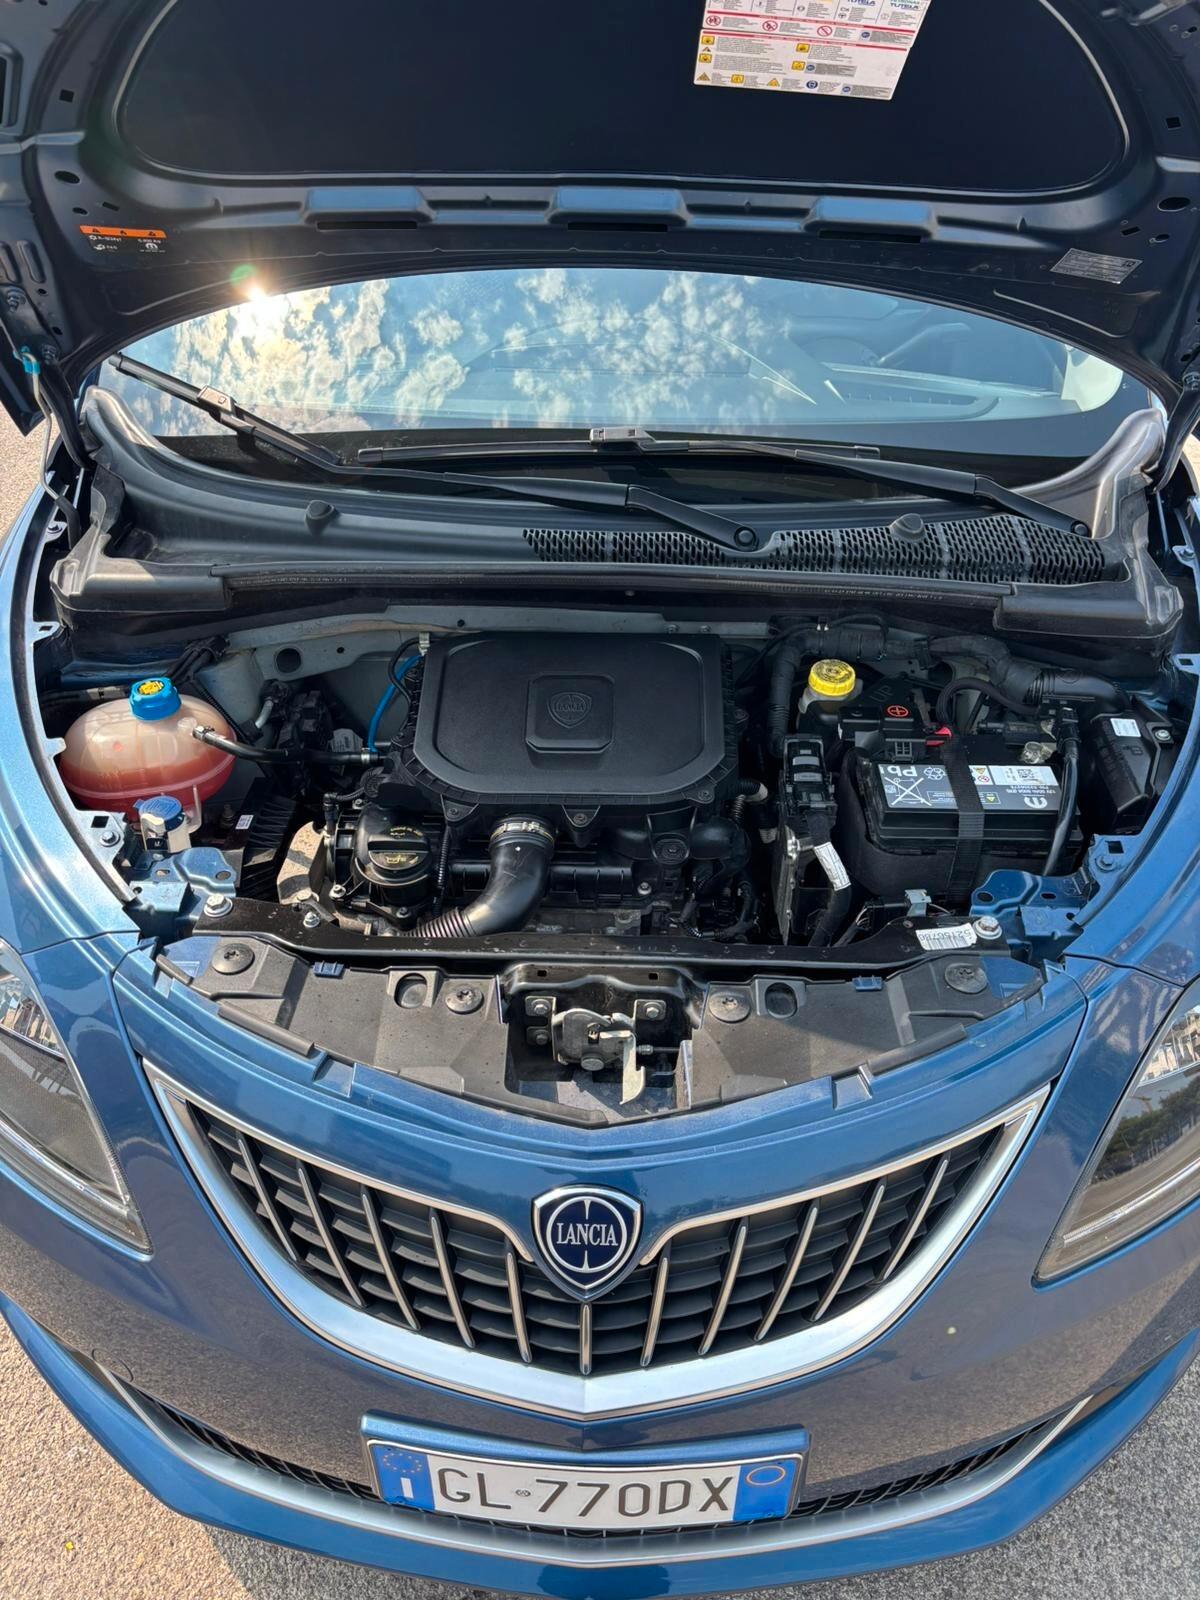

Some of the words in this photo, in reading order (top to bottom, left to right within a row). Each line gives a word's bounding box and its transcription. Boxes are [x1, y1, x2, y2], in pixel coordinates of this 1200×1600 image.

[890, 2, 920, 10] TUTELA
[886, 765, 918, 777] Pb
[556, 1222, 619, 1246] LANCIA
[436, 1467, 512, 1510] GL
[534, 1474, 734, 1518] 770DX
